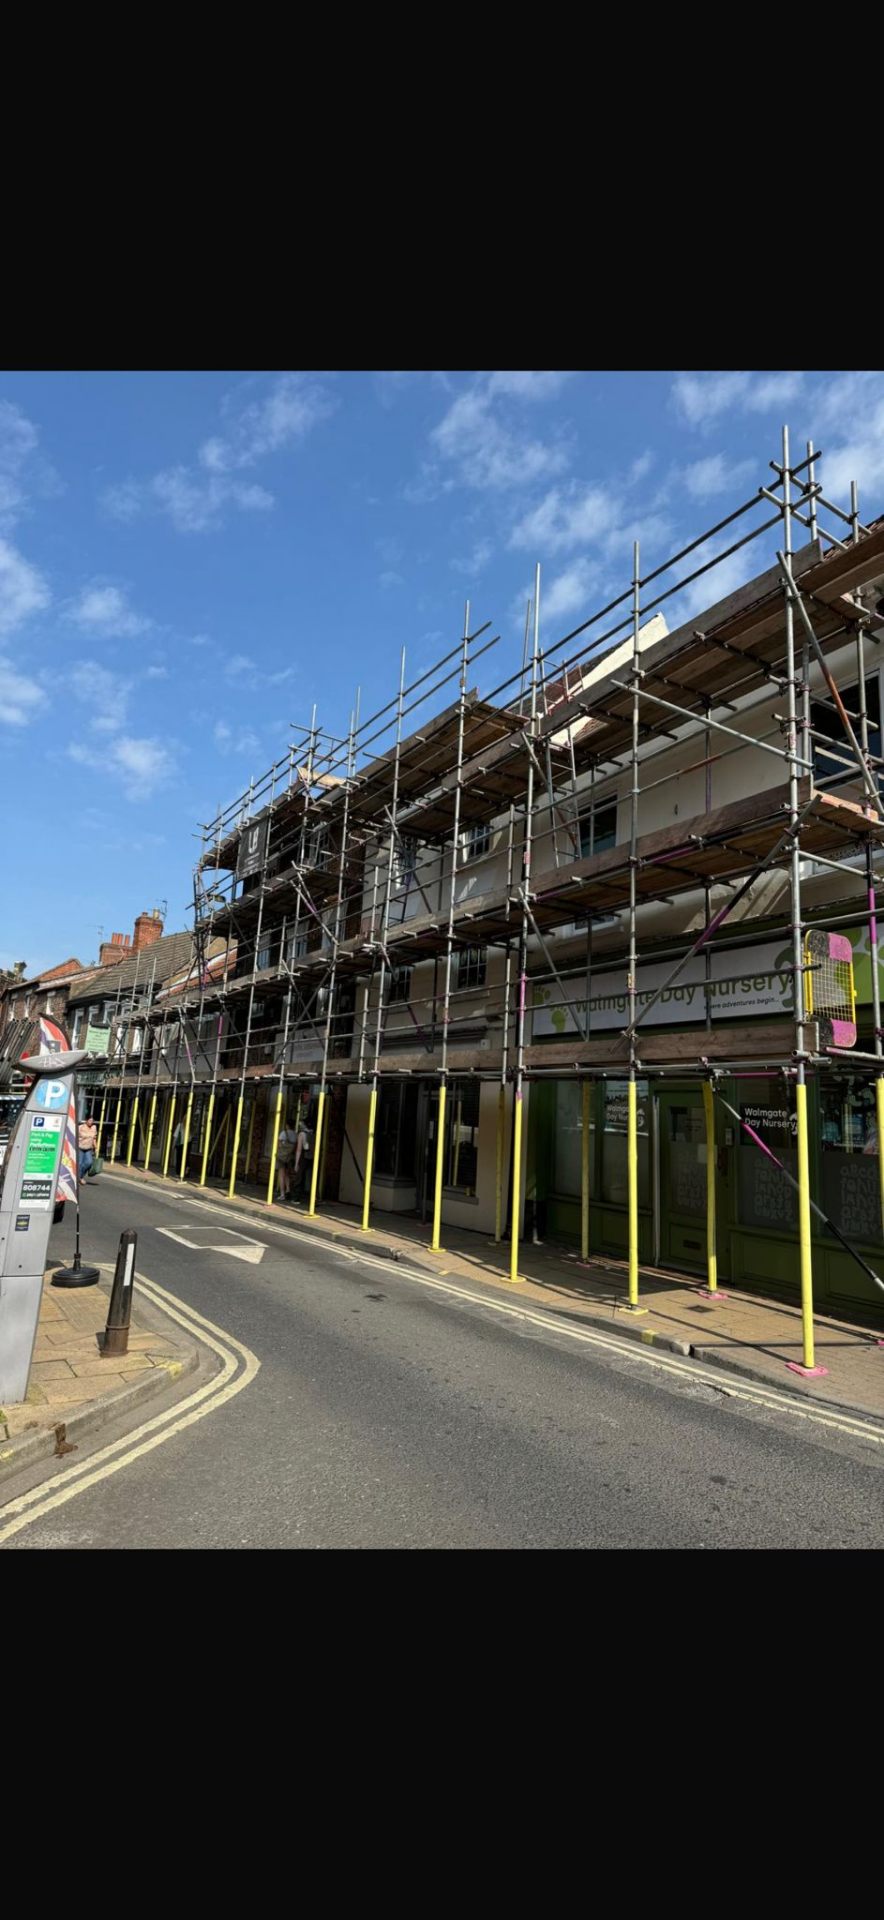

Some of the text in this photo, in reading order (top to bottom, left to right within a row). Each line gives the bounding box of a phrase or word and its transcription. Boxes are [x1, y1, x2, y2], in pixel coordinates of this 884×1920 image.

[661, 984, 696, 1005] Day
[704, 974, 790, 997] Nursery
[722, 1000, 756, 1009] adventures
[44, 1081, 66, 1107] P
[745, 1108, 788, 1119] Walmgate
[745, 1118, 796, 1131] Day Nursery
